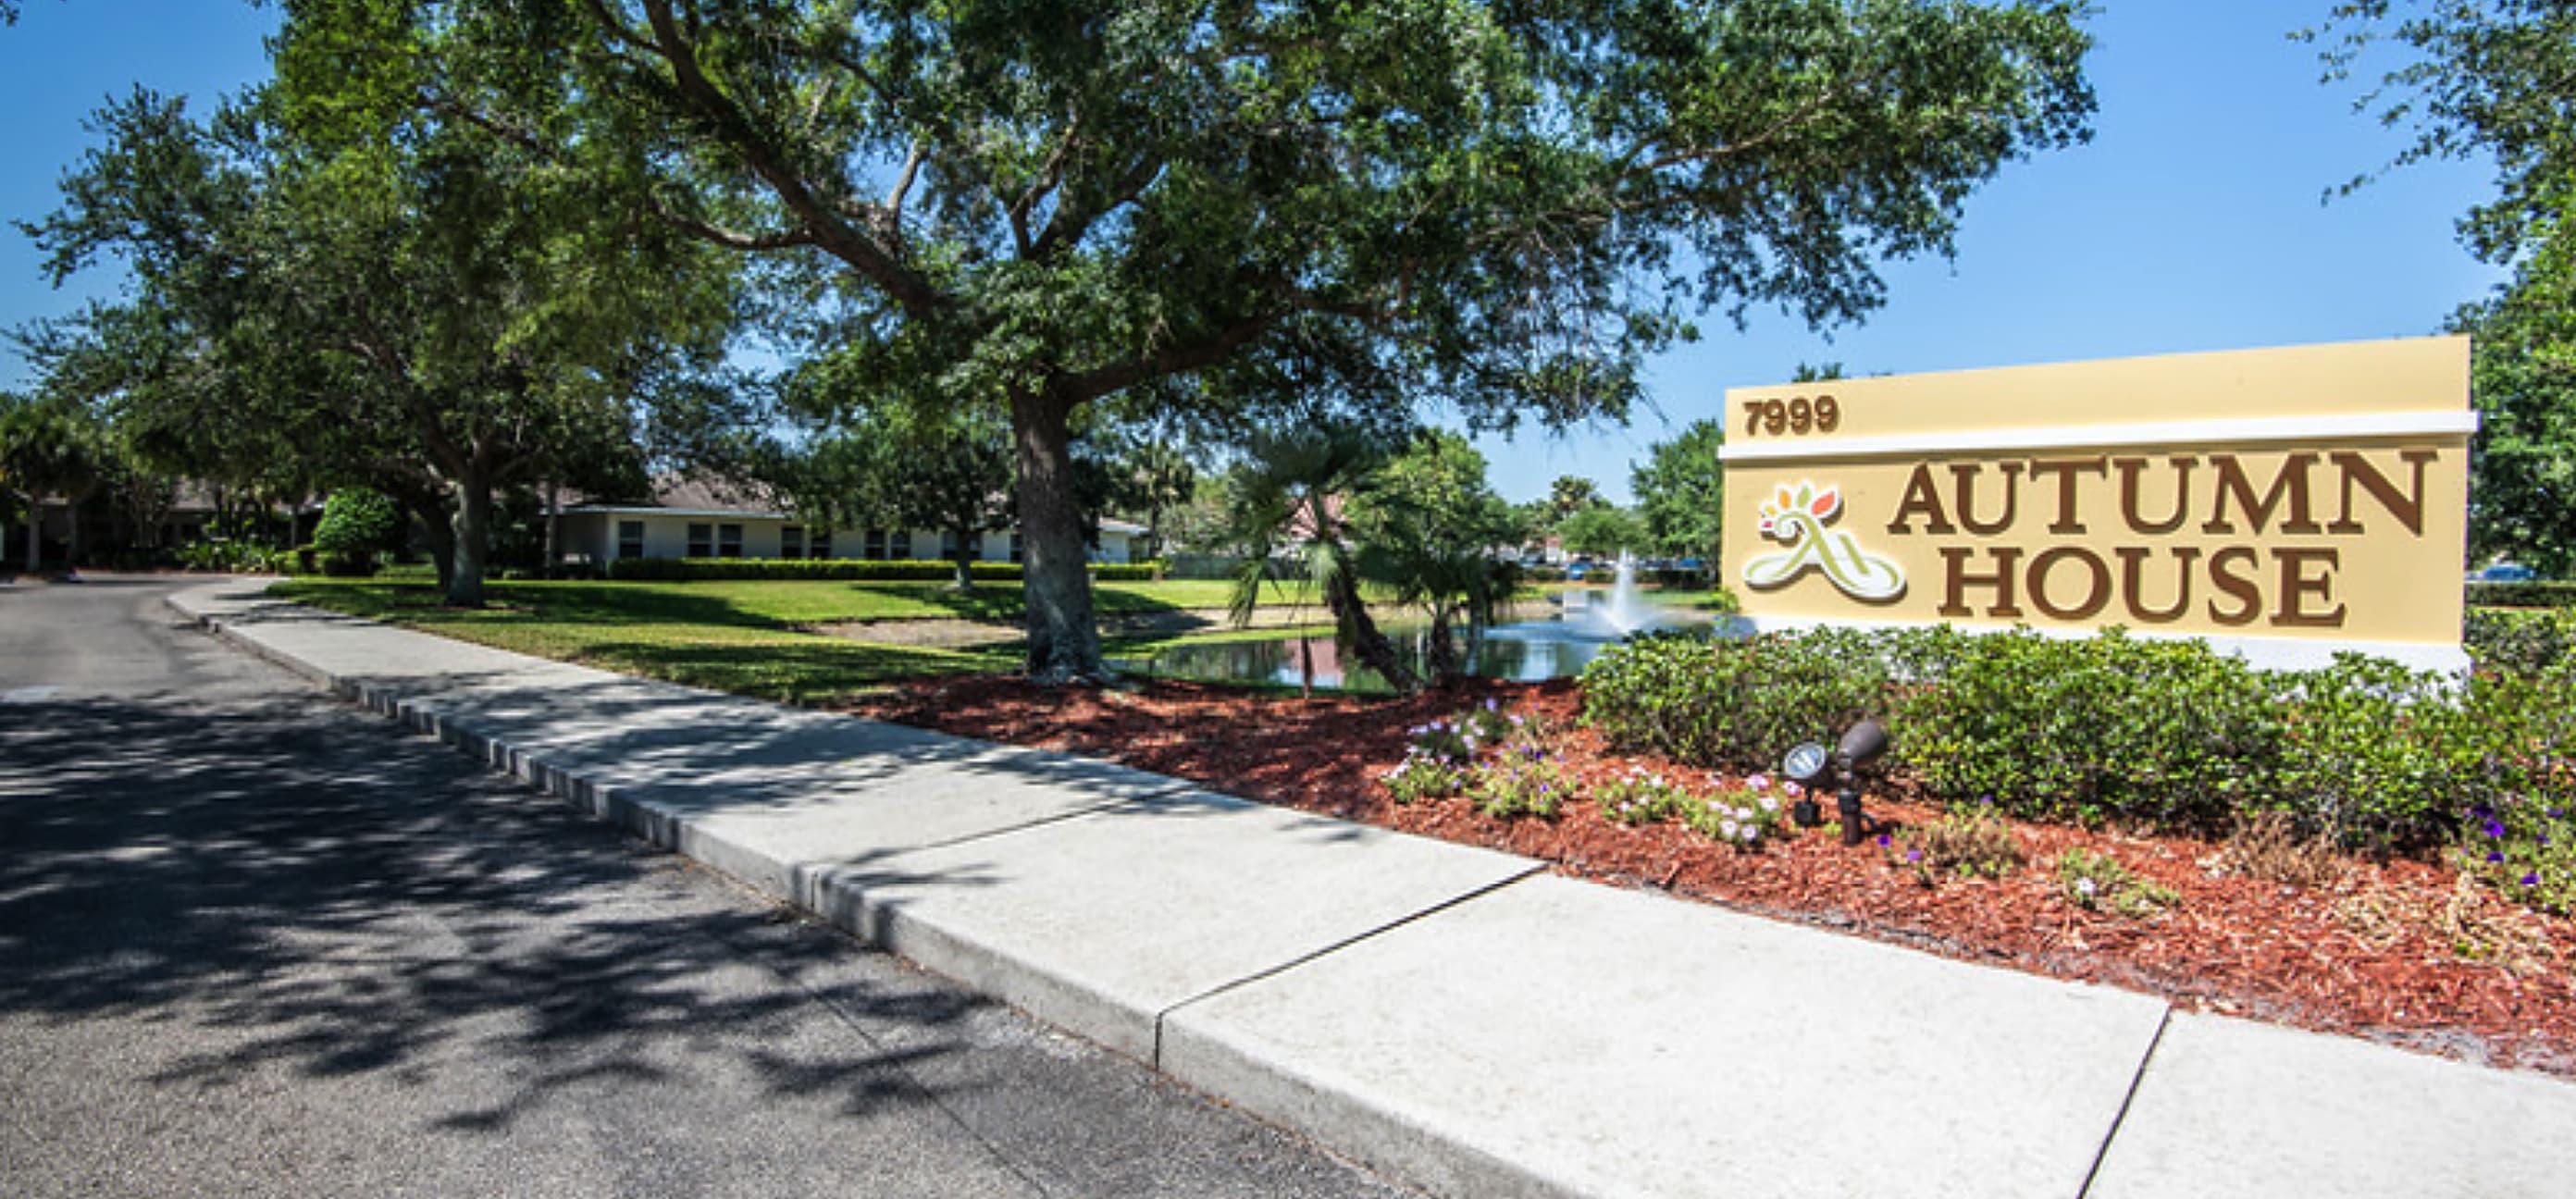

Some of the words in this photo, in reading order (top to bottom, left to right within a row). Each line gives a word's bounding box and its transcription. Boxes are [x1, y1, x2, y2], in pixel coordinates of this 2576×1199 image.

[1743, 395, 1839, 436] 7999
[1887, 450, 2438, 537] AUTUMN
[1938, 546, 2346, 627] HOUSE
